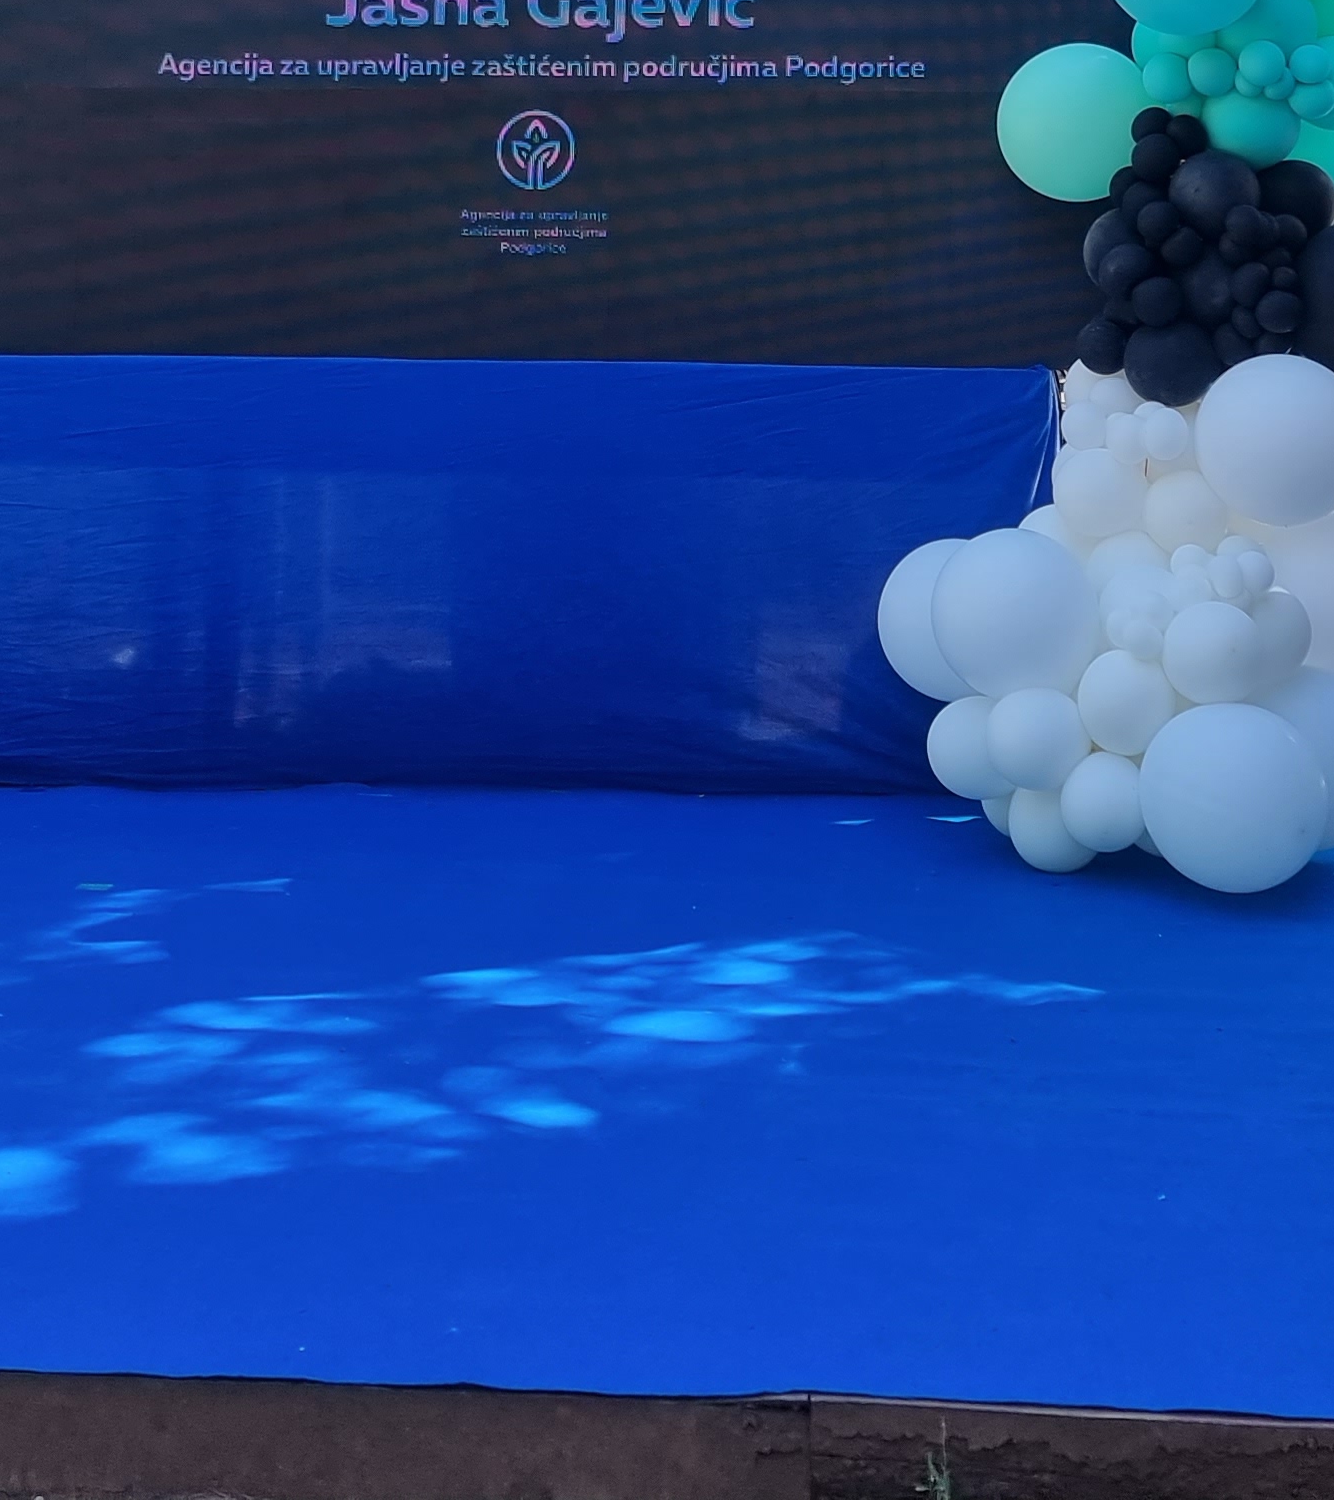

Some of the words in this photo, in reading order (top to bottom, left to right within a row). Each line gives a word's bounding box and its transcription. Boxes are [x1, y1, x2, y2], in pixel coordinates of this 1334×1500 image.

[158, 53, 274, 81] Agencija
[280, 59, 310, 76] za
[317, 54, 465, 82] upravljanje
[471, 54, 616, 77] zaštićenim
[623, 55, 778, 83] područjima
[785, 55, 926, 85] Podgorice
